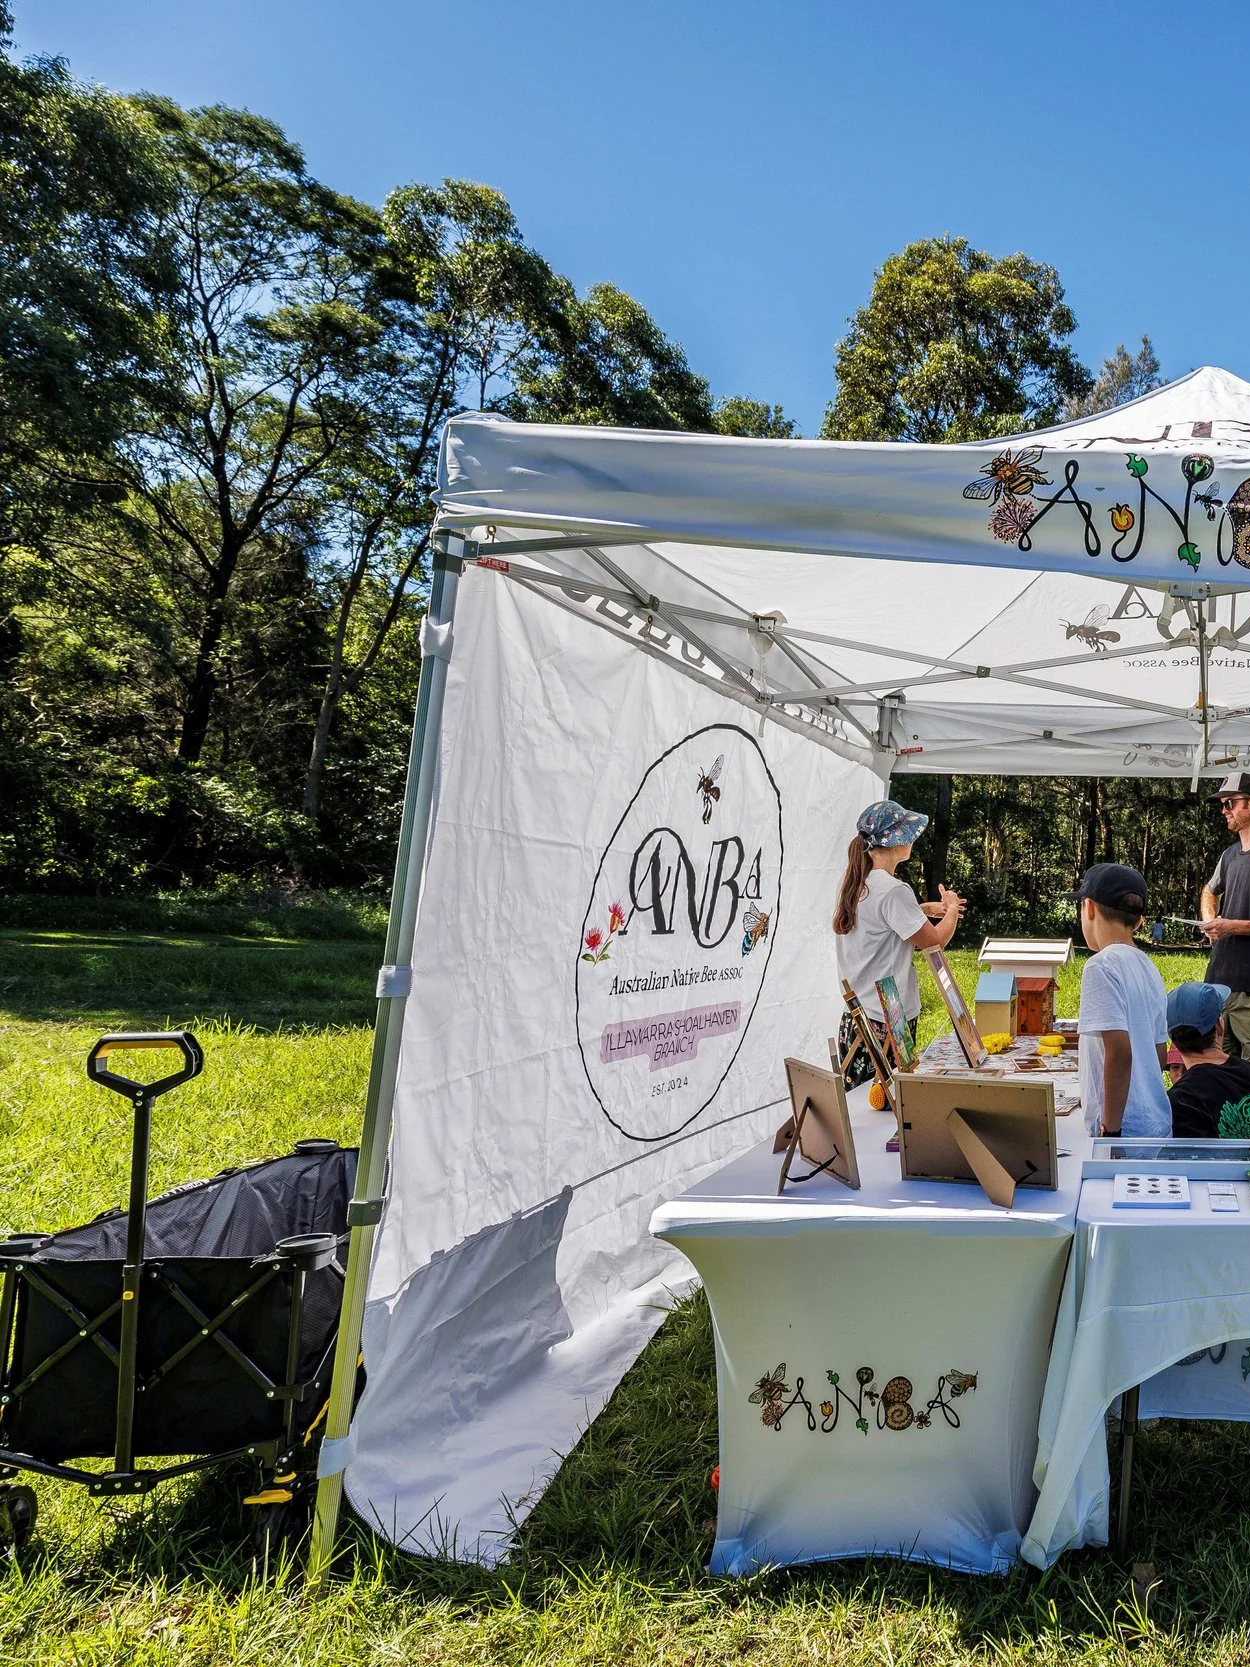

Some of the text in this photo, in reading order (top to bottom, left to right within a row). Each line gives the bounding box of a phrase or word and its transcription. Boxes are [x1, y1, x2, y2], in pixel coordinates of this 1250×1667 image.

[608, 965, 744, 996] Australian Native Bee ASSOC
[653, 1034, 695, 1062] BRANCH
[773, 1366, 961, 1437] ANBA
